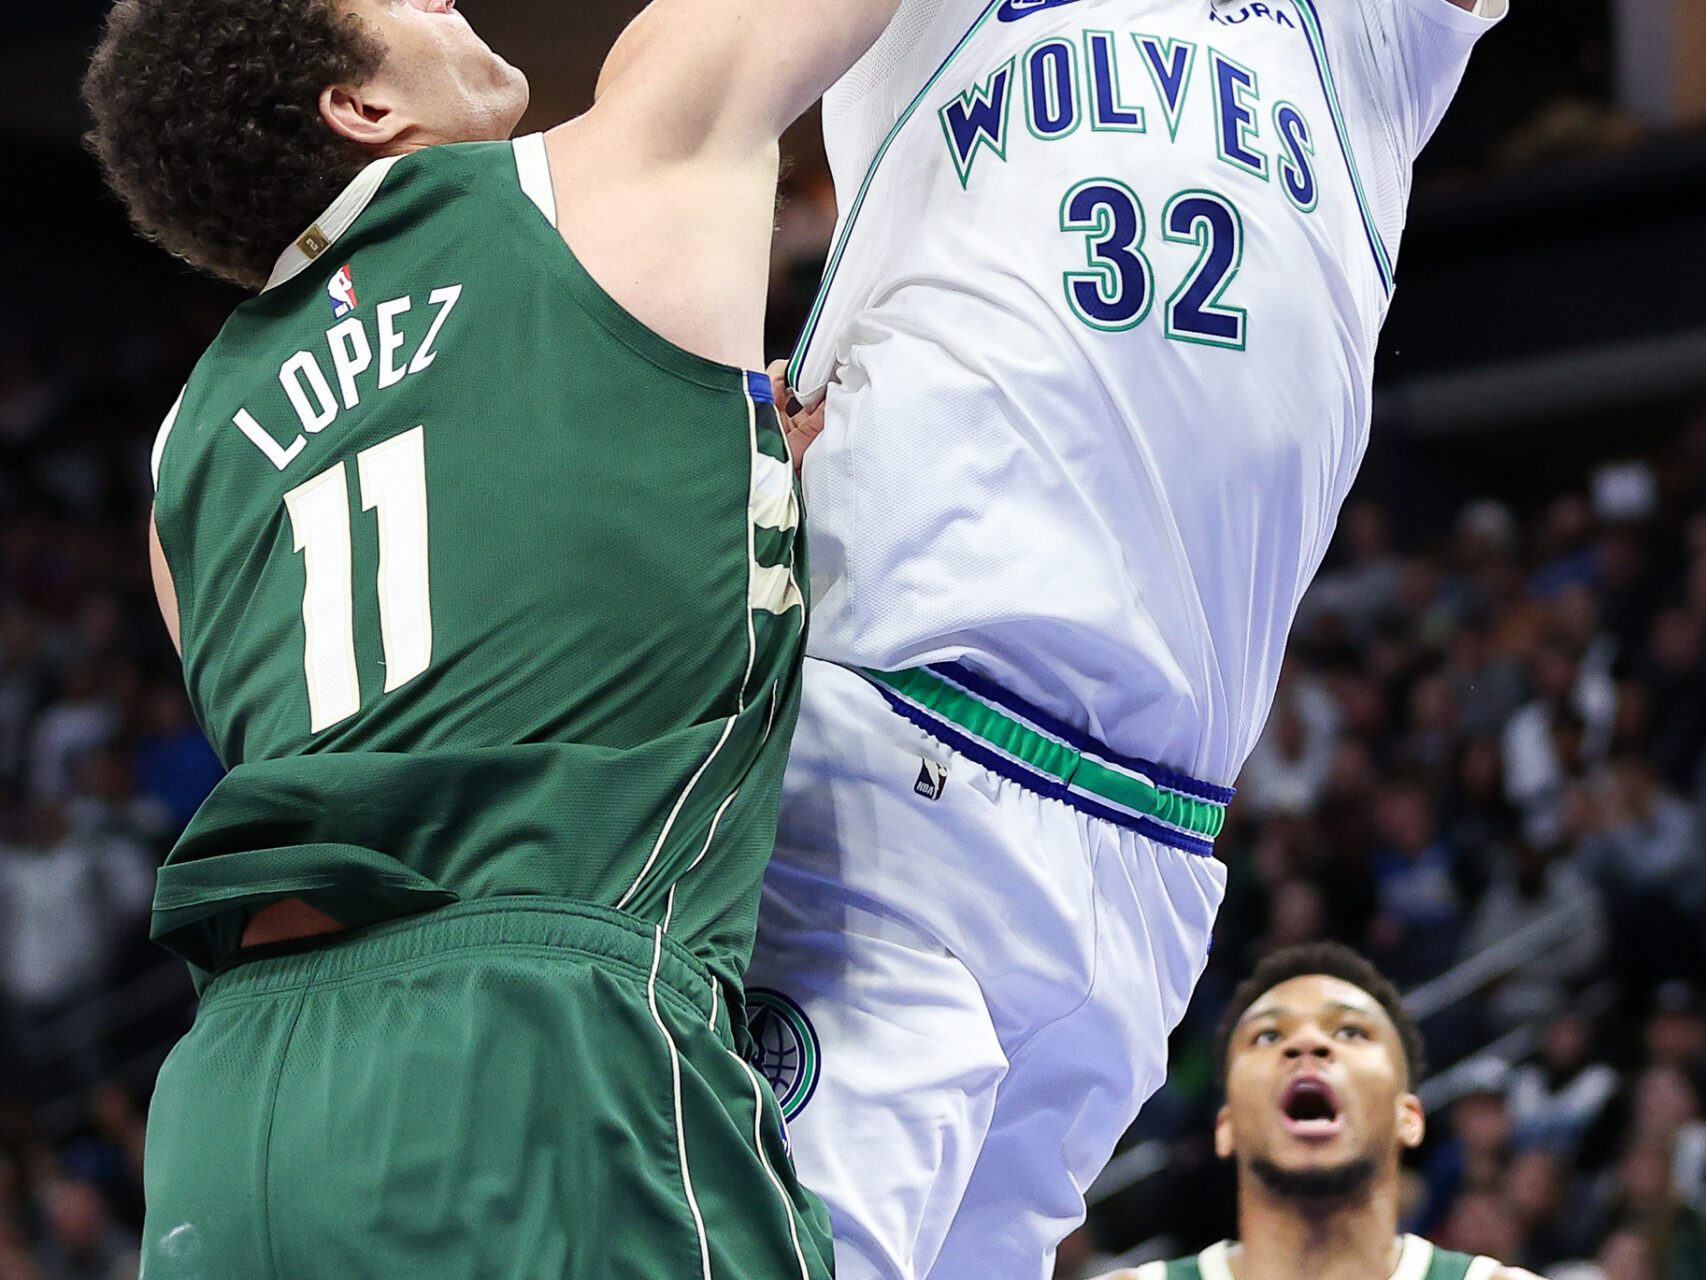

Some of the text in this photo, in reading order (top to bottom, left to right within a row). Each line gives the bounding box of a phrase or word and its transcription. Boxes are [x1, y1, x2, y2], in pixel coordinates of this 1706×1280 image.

[937, 28, 1320, 214] WOLVES
[1060, 176, 1248, 352] 32
[231, 284, 463, 472] LOPEZ
[282, 424, 434, 735] 11
[916, 780, 935, 796] NBA
